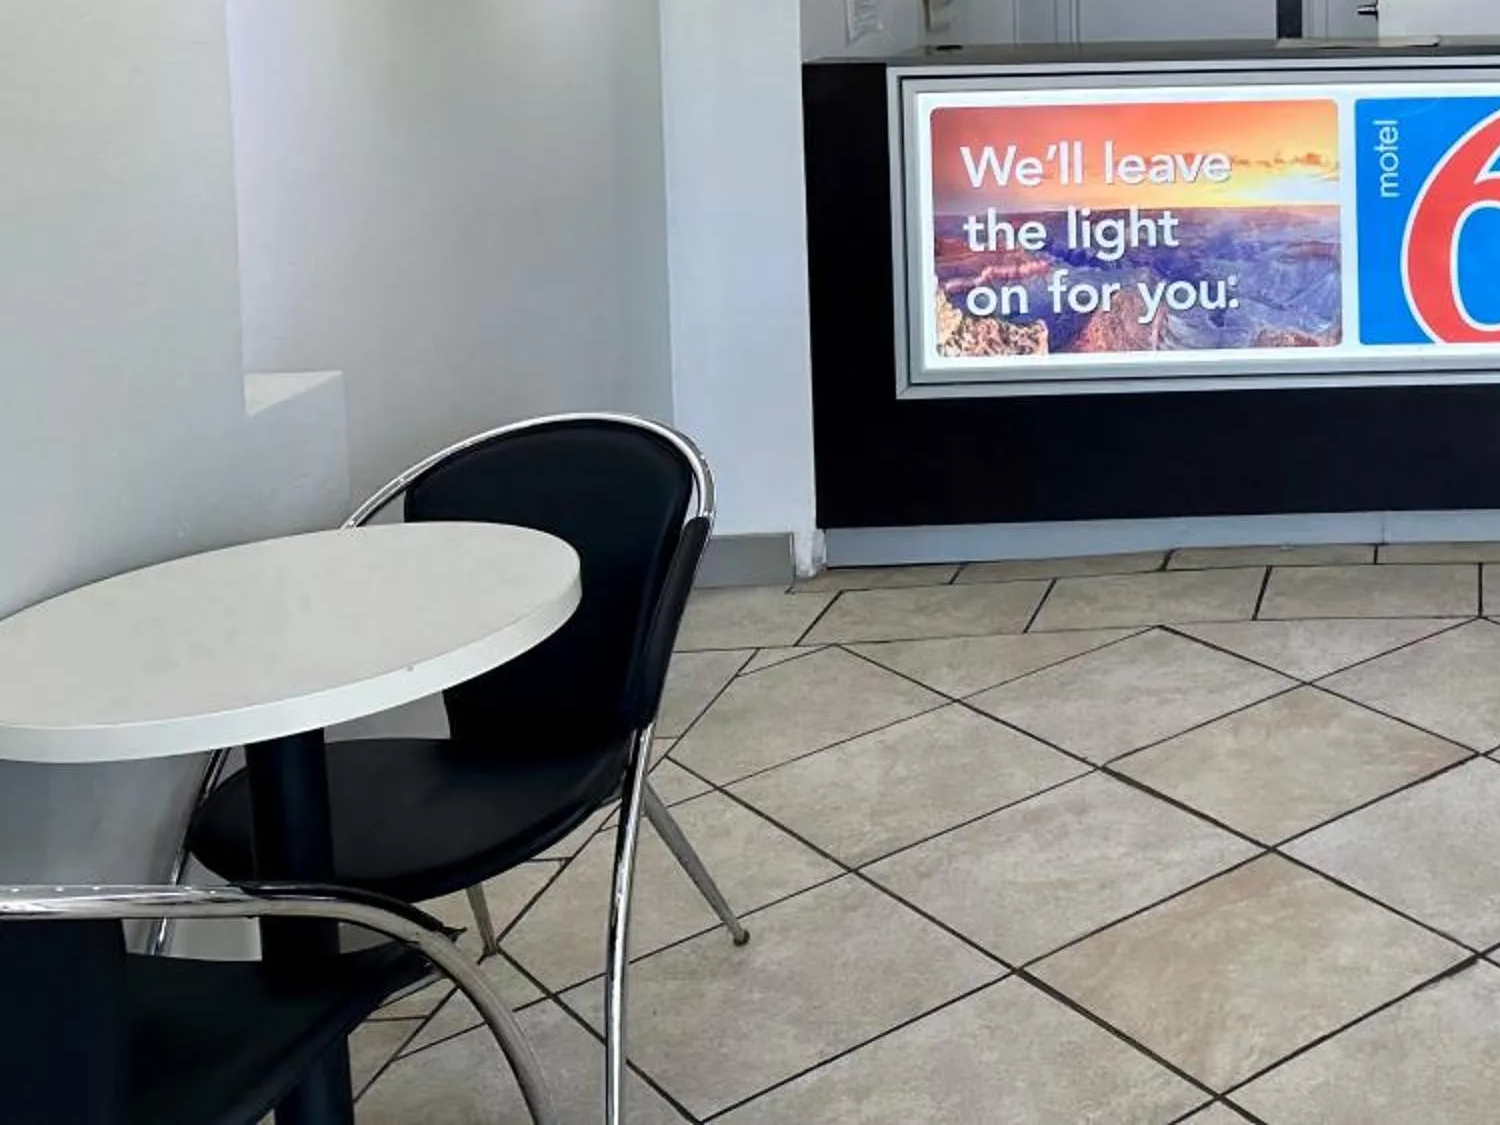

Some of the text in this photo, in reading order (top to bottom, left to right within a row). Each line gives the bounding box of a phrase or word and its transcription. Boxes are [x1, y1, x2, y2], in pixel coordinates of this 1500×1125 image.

[960, 140, 1234, 188] We'll leave
[1379, 119, 1399, 198] motel
[963, 205, 1180, 261] the light
[966, 276, 1030, 318] on
[1047, 269, 1121, 315] for
